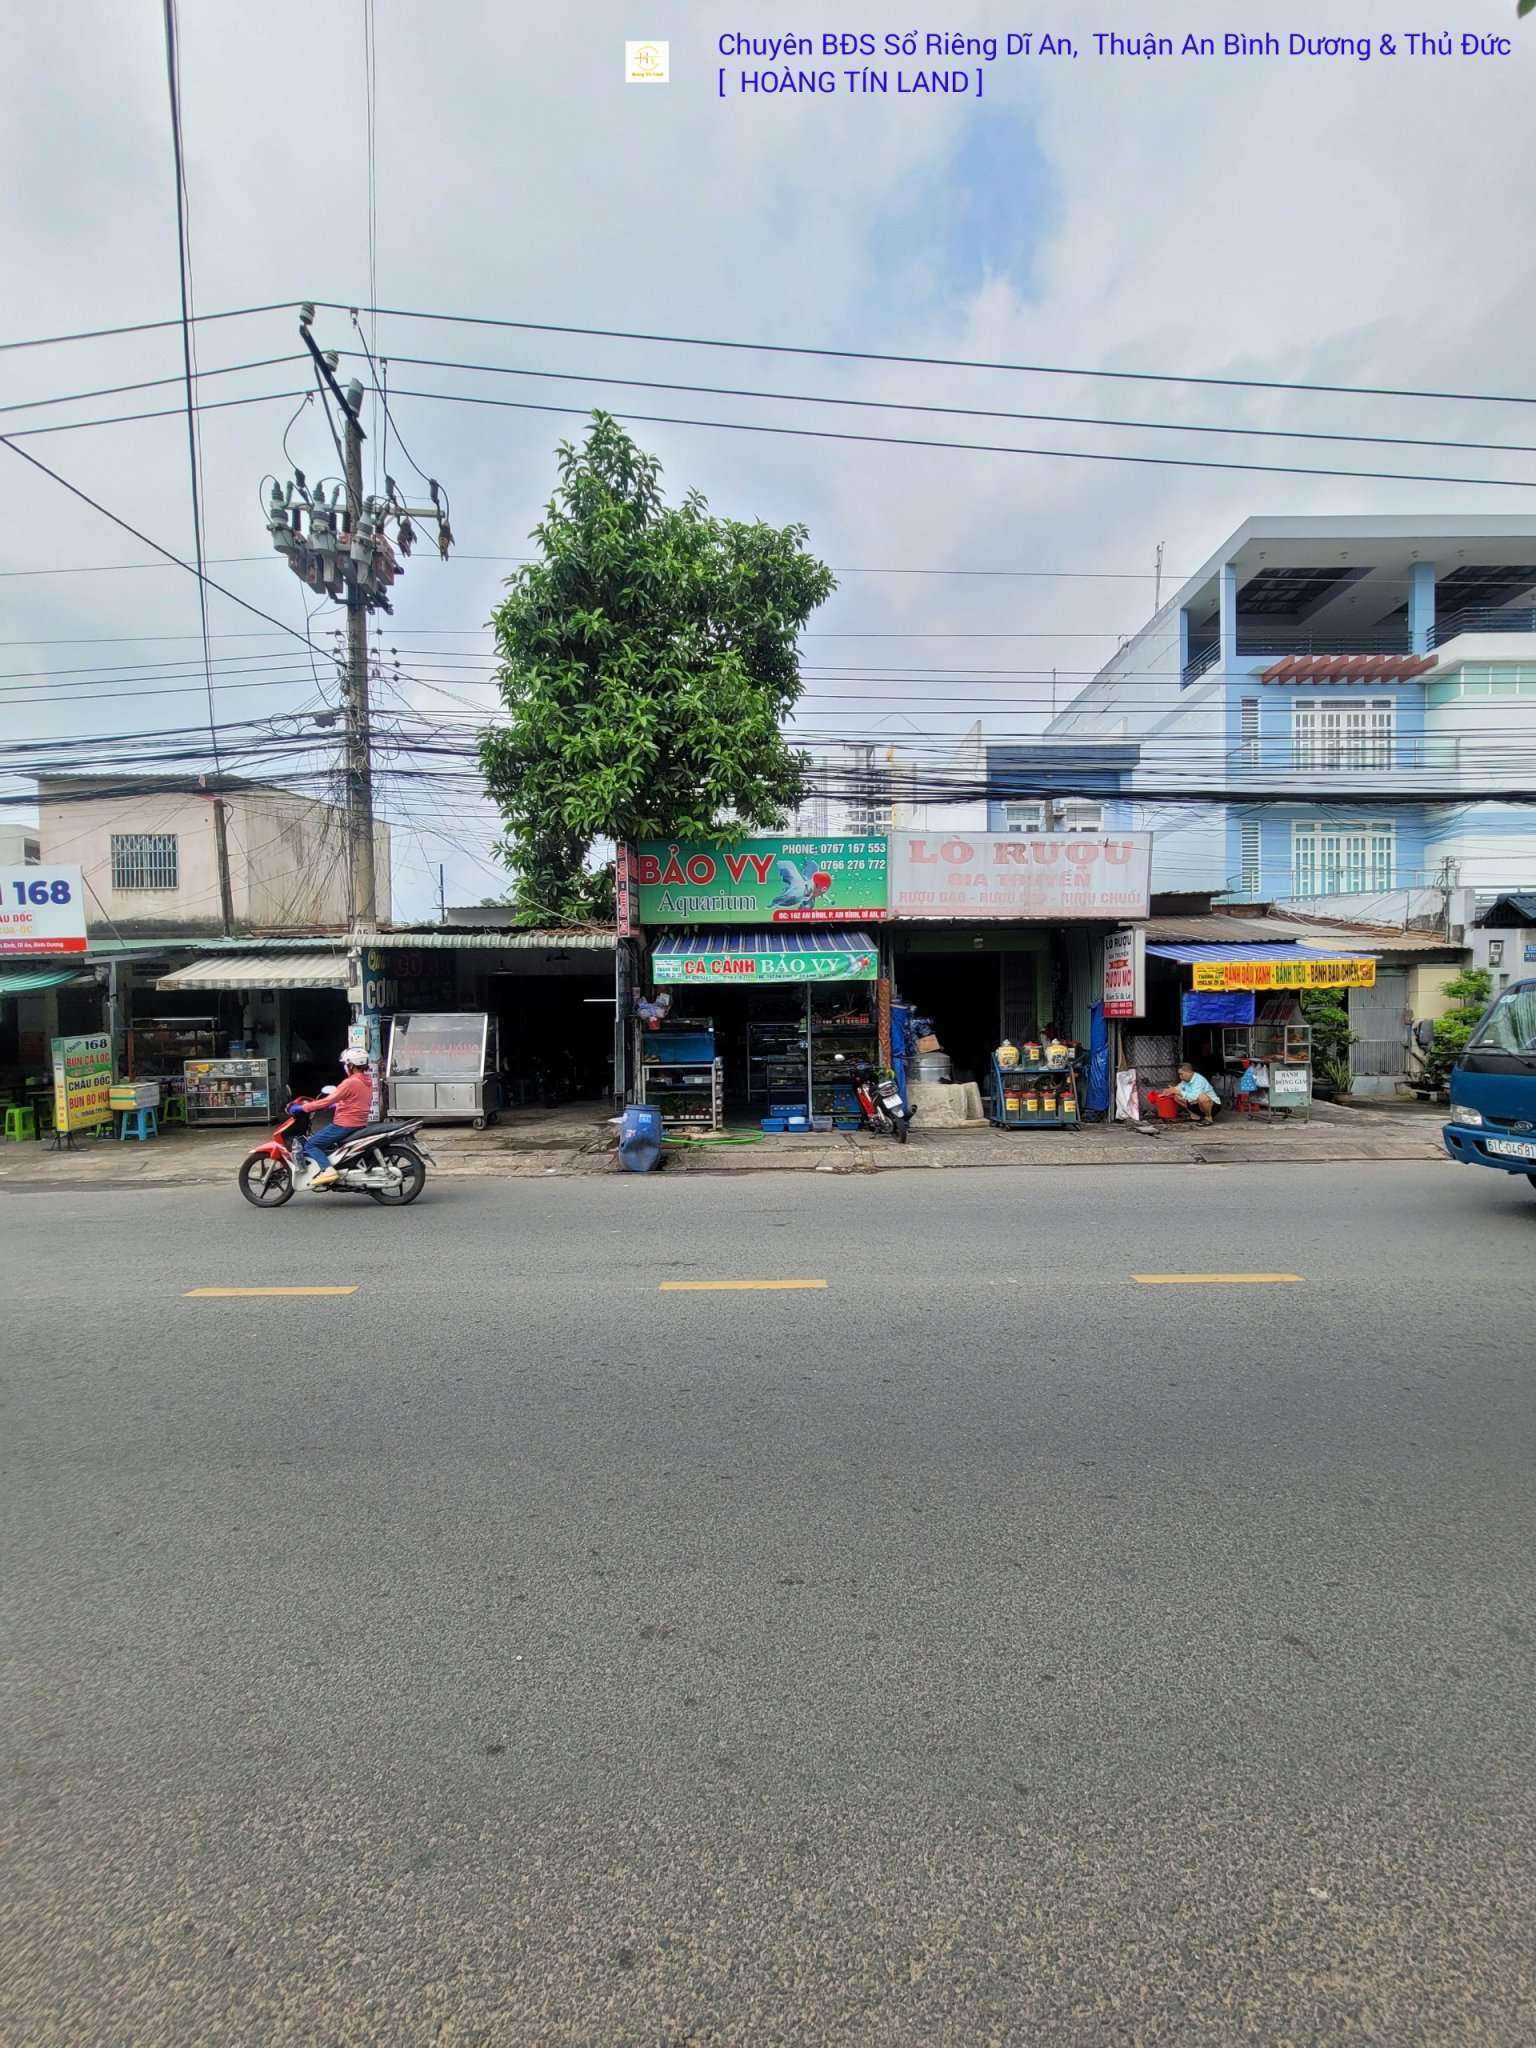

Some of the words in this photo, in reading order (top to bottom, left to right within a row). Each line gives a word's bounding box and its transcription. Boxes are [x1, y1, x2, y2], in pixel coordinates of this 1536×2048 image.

[782, 844, 818, 855] PHONE:
[867, 842, 886, 853] 553
[908, 834, 975, 865] LÒ
[639, 843, 717, 886] BẢO
[722, 853, 777, 885] VY
[868, 860, 886, 870] 772
[12, 880, 71, 906] 168
[657, 889, 759, 918] Aquarium
[761, 954, 806, 974] BẢO
[811, 957, 840, 974] VY
[85, 1038, 108, 1051] 168
